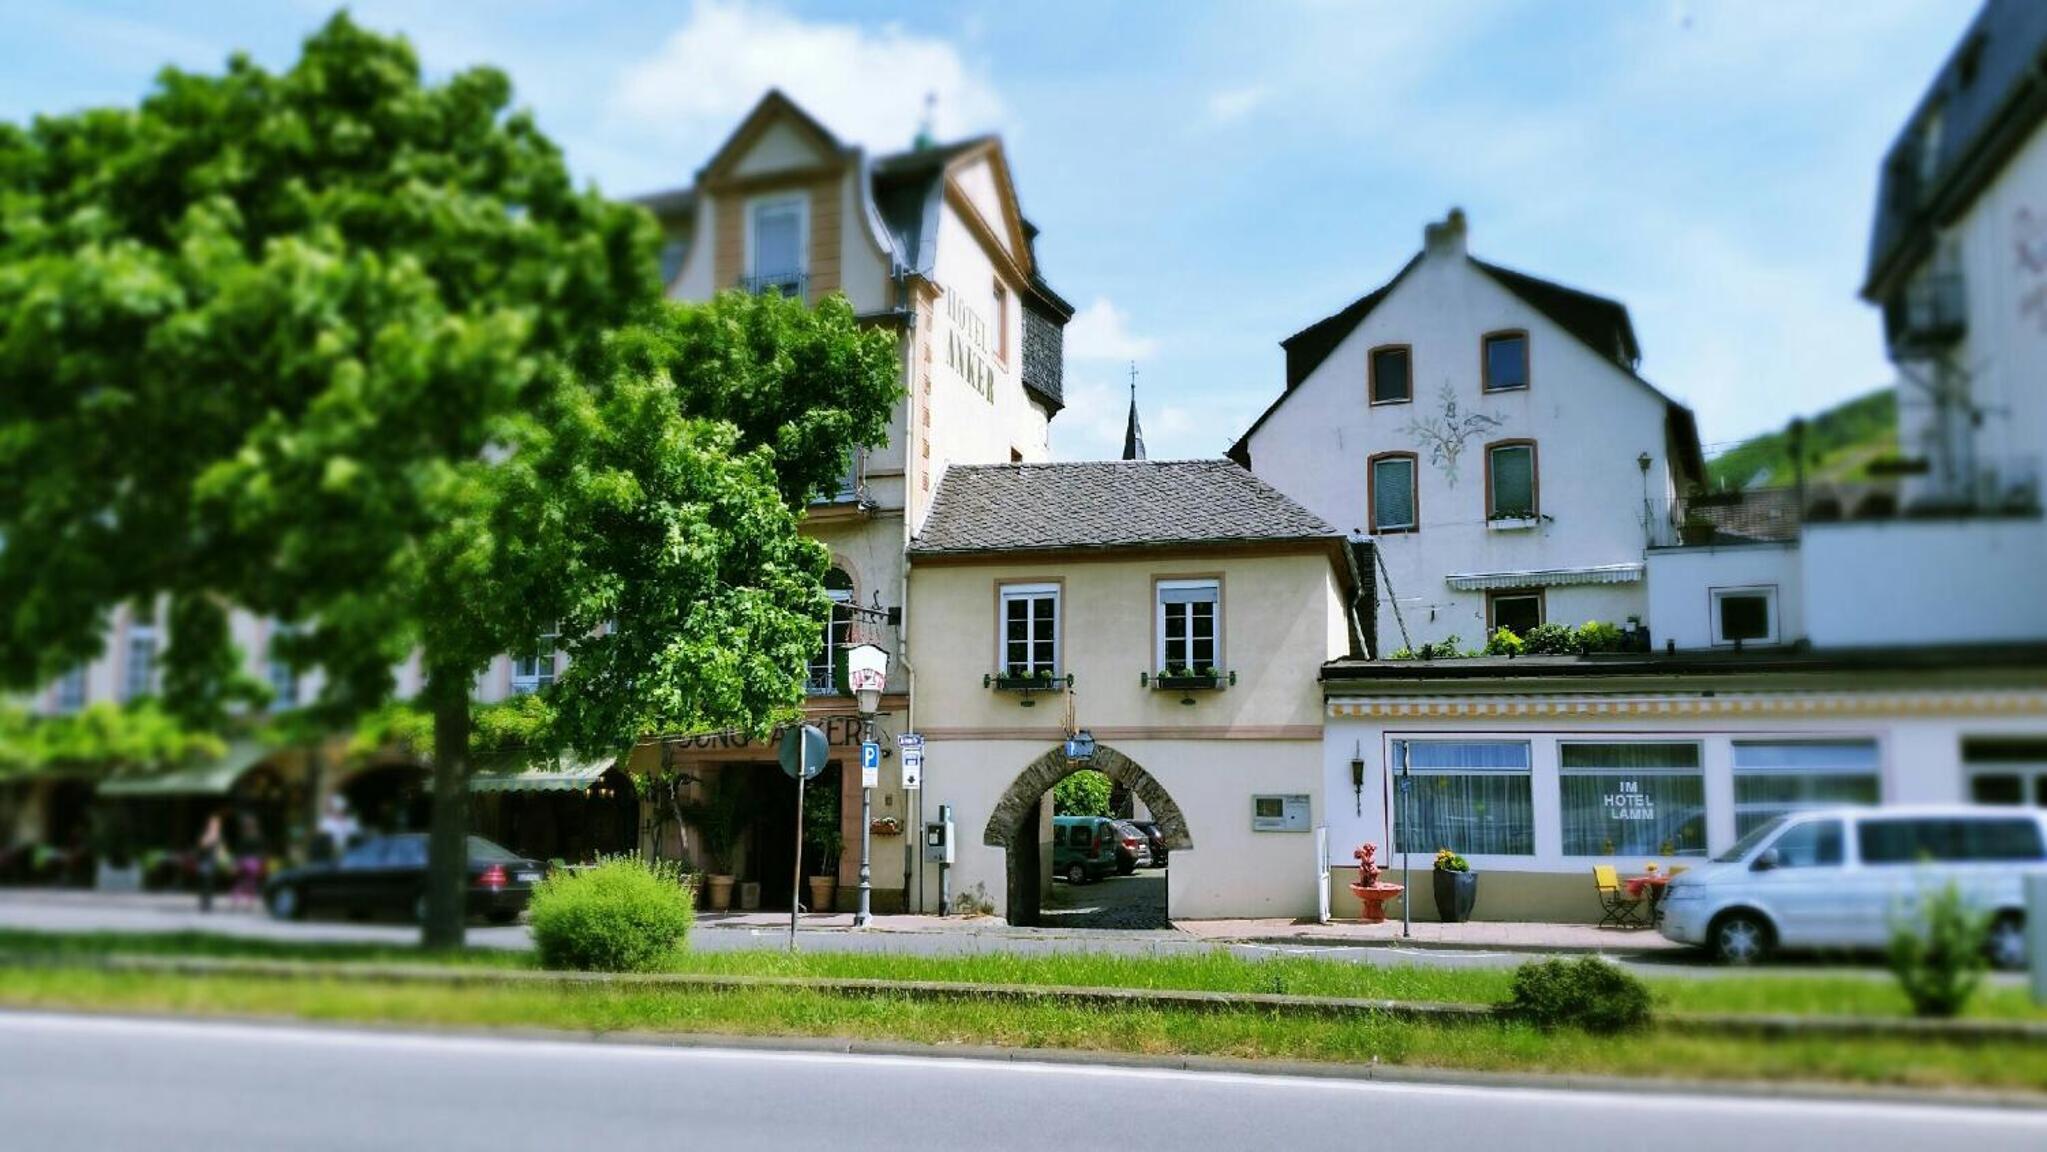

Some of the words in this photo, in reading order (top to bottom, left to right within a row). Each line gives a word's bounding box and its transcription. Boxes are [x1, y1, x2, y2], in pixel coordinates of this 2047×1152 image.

[946, 327, 994, 406] ANKER
[769, 717, 862, 747] AER
[865, 747, 876, 768] P
[1620, 781, 1638, 792] IM
[1604, 794, 1654, 807] HOTEL
[1612, 808, 1654, 820] LAMM
